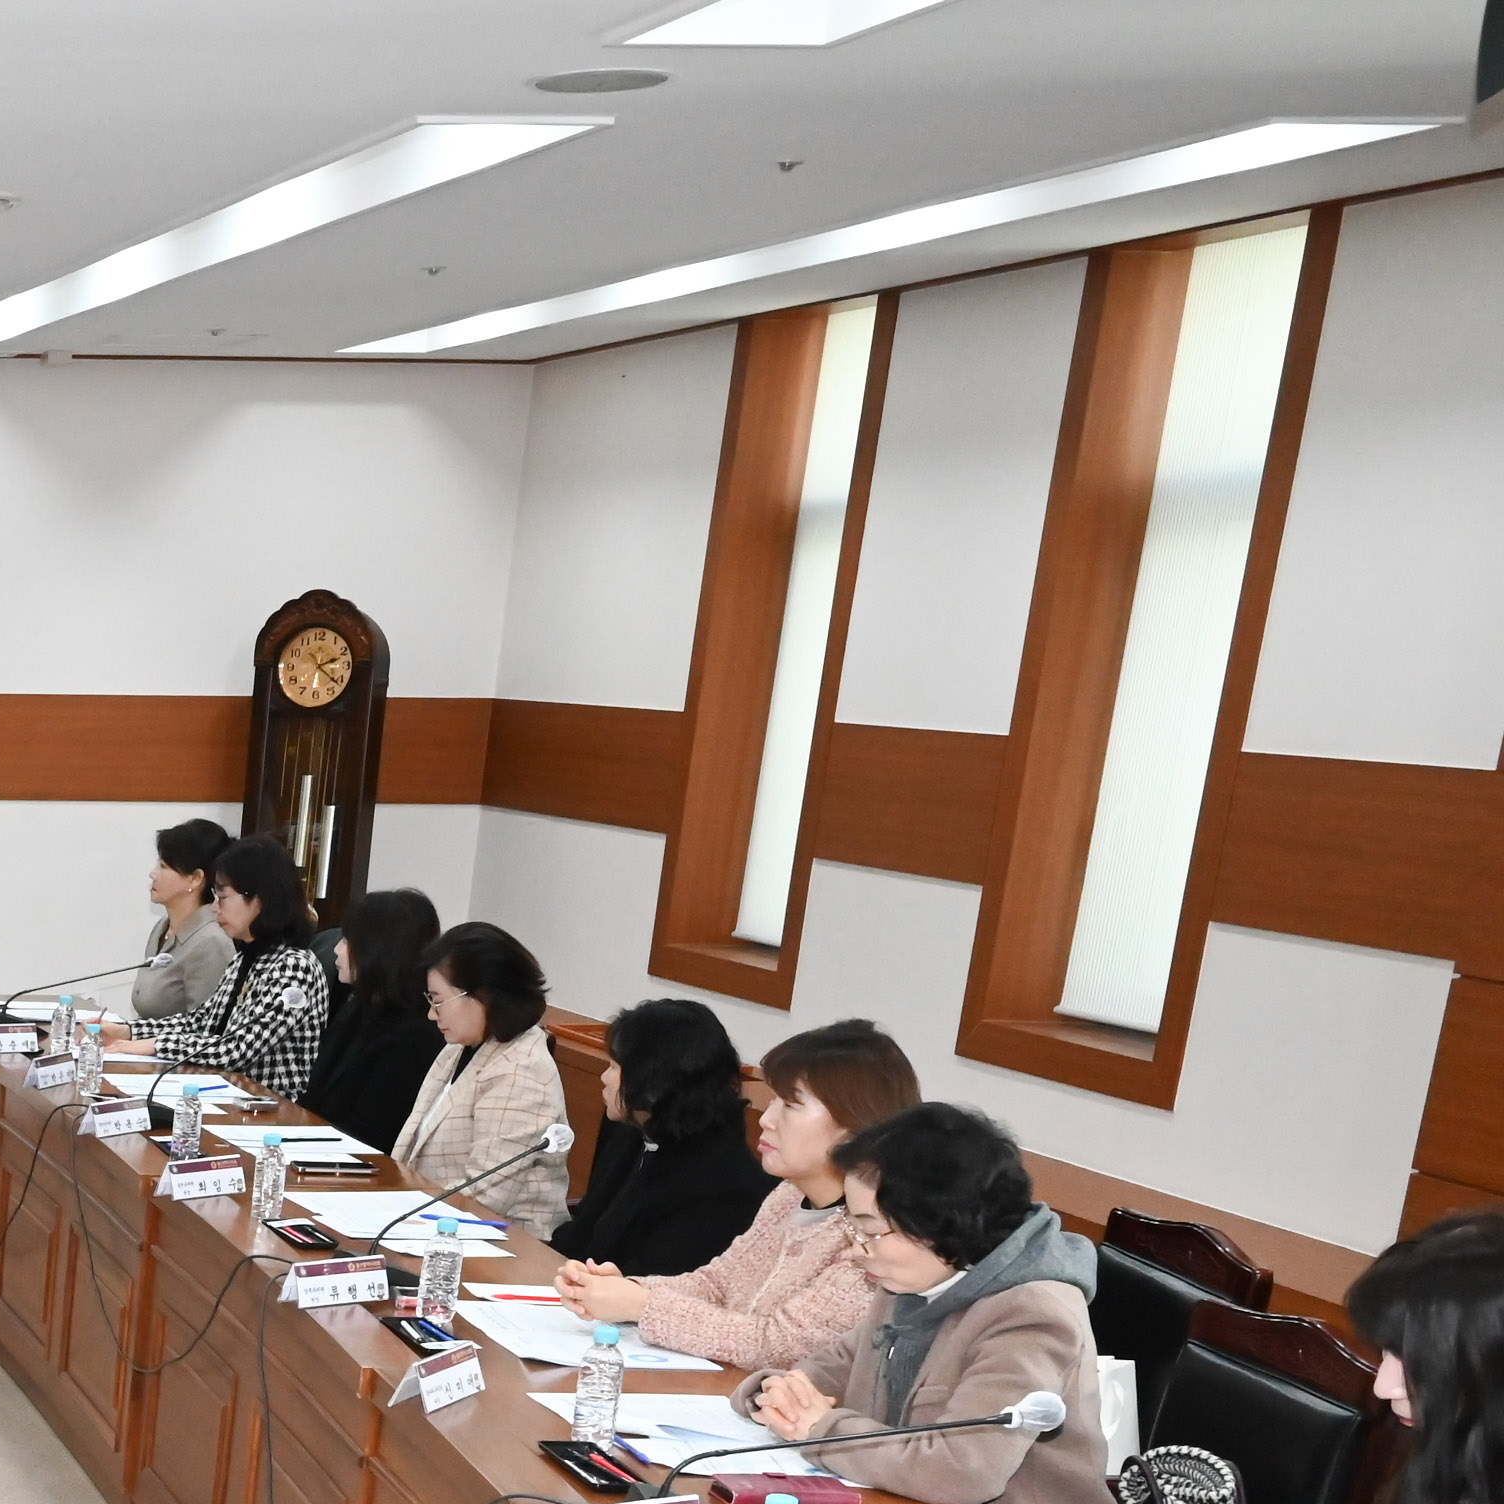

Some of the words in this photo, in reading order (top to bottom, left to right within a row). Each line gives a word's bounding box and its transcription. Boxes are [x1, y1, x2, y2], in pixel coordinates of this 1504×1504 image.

[314, 631, 326, 641] 12
[301, 638, 310, 646] 11
[291, 648, 301, 658] 10
[340, 647, 347, 656] 2
[287, 663, 294, 671] 9
[343, 661, 350, 670] 3
[289, 676, 297, 685] 8
[299, 687, 307, 695] 7
[326, 686, 335, 695] 5
[312, 691, 320, 700] 6
